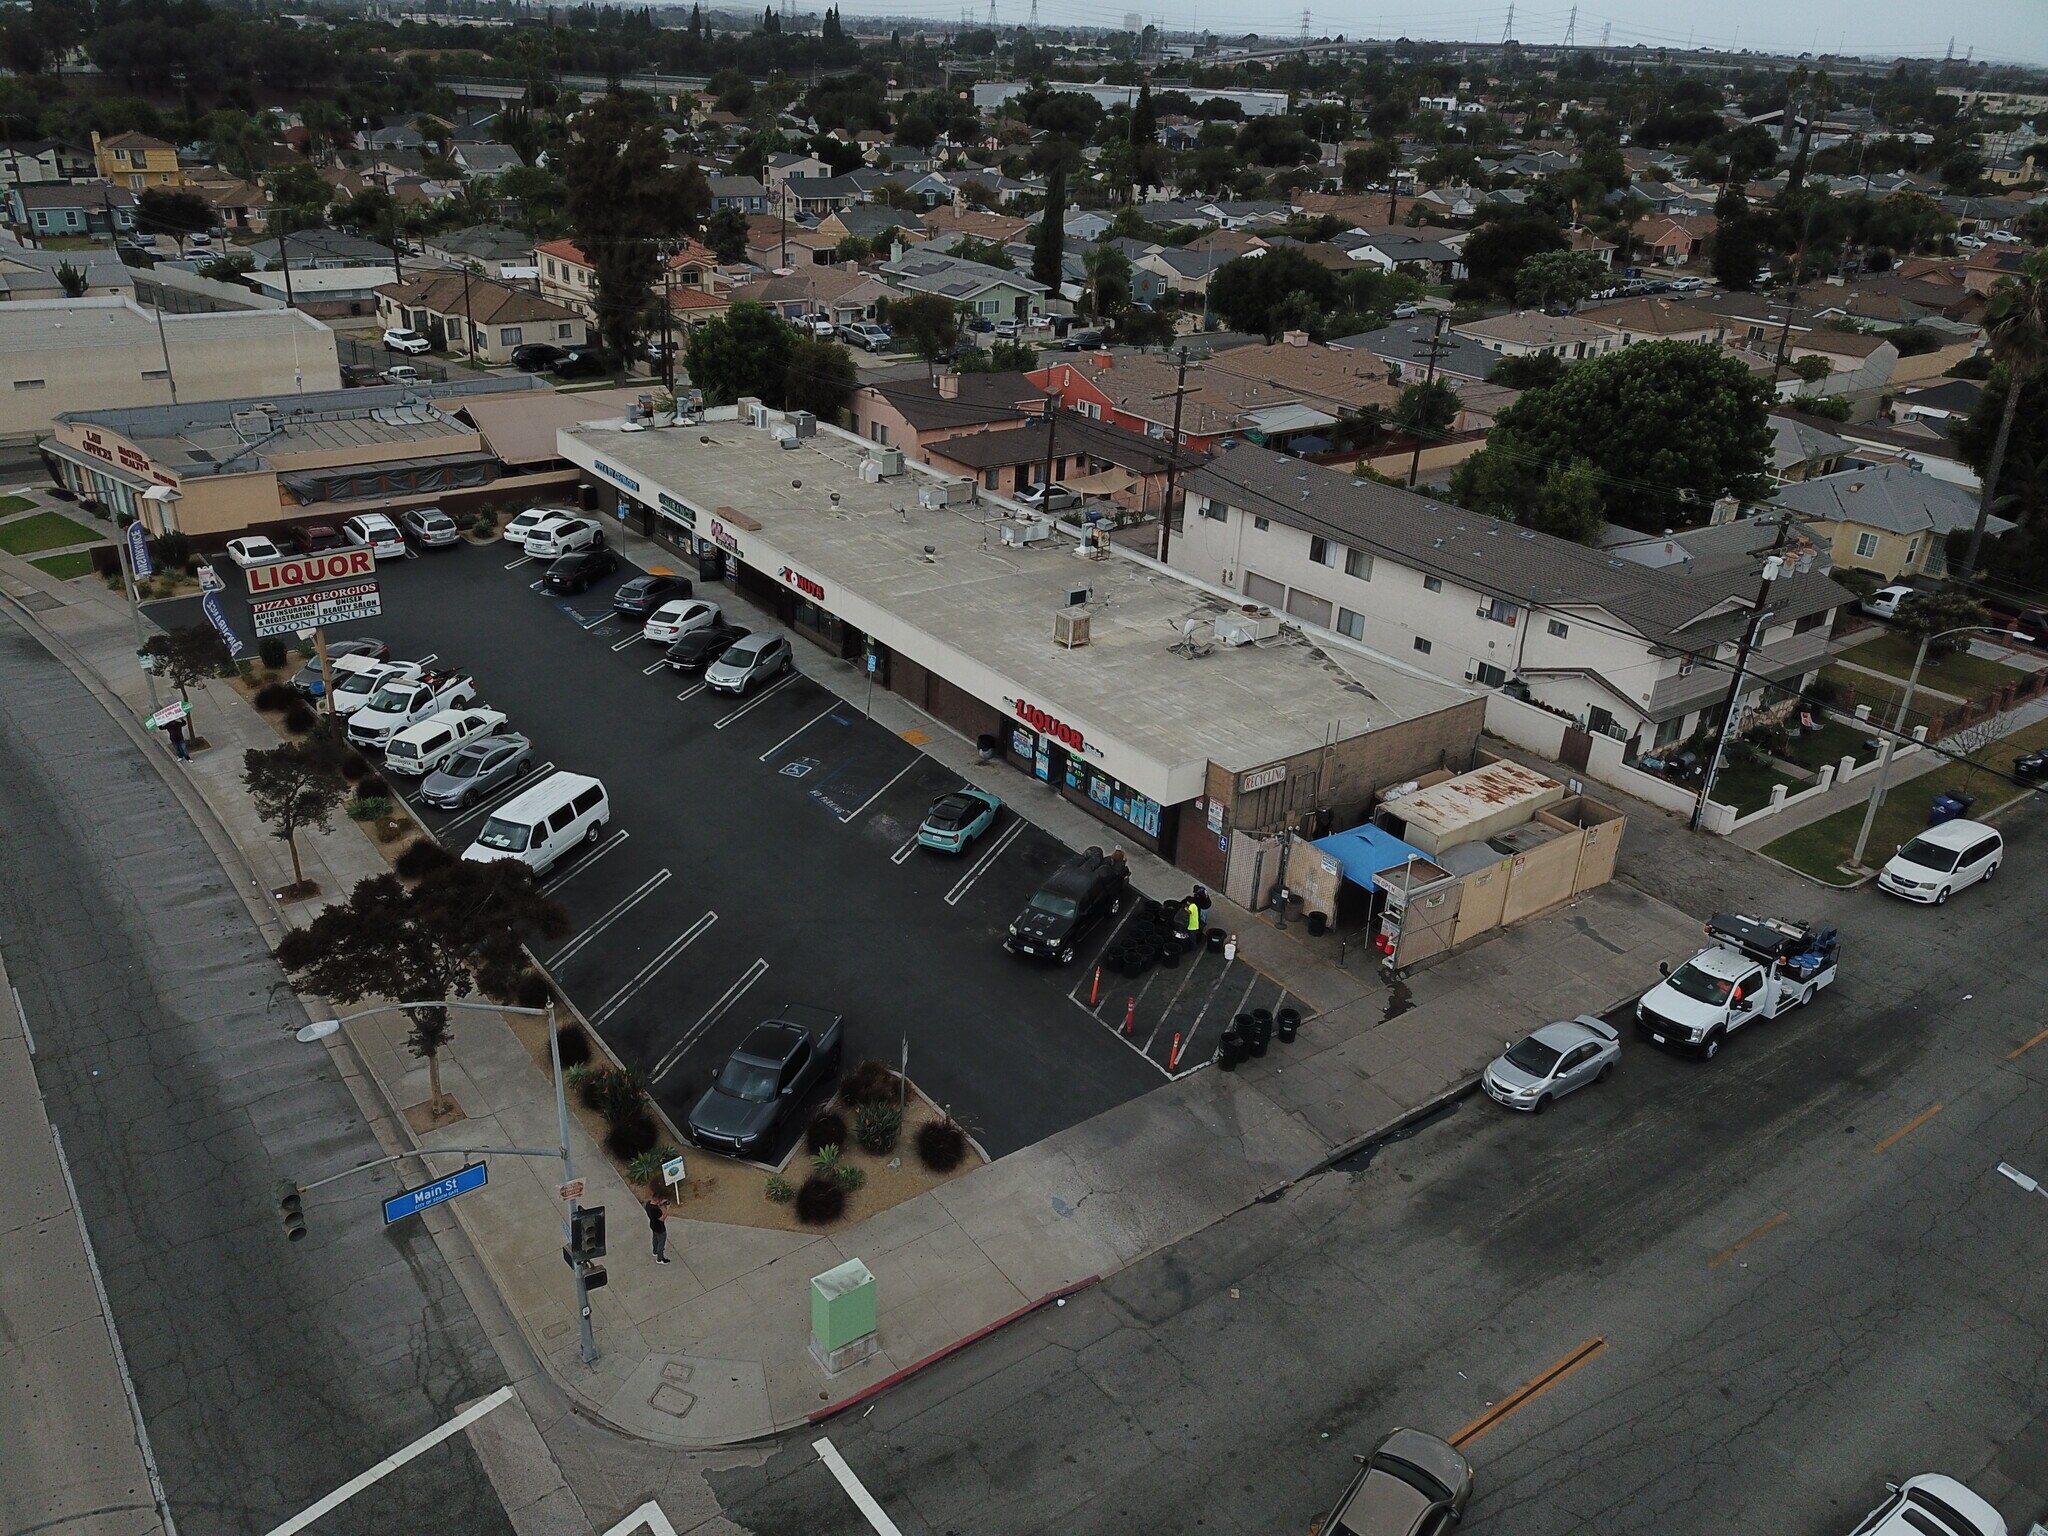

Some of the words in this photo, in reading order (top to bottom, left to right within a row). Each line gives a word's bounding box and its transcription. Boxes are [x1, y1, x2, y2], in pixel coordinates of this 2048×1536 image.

[249, 552, 371, 591] LIQUOR
[253, 598, 292, 613] PIZZA
[294, 595, 310, 606] BY
[312, 583, 377, 602] GEORGIOS
[323, 605, 351, 614] BEAUTY
[353, 599, 377, 610] SALON
[335, 596, 363, 606] UNISEX
[256, 612, 275, 621] AUTO
[276, 604, 316, 617] INSURANCE
[262, 619, 312, 636] MOON
[317, 607, 377, 625] DONUTS
[265, 610, 315, 625] REGISTRATION
[1016, 699, 1085, 752] LIQUOR
[1246, 766, 1285, 789] RECYCLING
[1380, 880, 1396, 894] OPEN
[414, 1186, 442, 1204] Main
[445, 1178, 458, 1191] St
[415, 1202, 425, 1210] CITY
[433, 1192, 448, 1203] SOUTH
[448, 1188, 459, 1196] GATE
